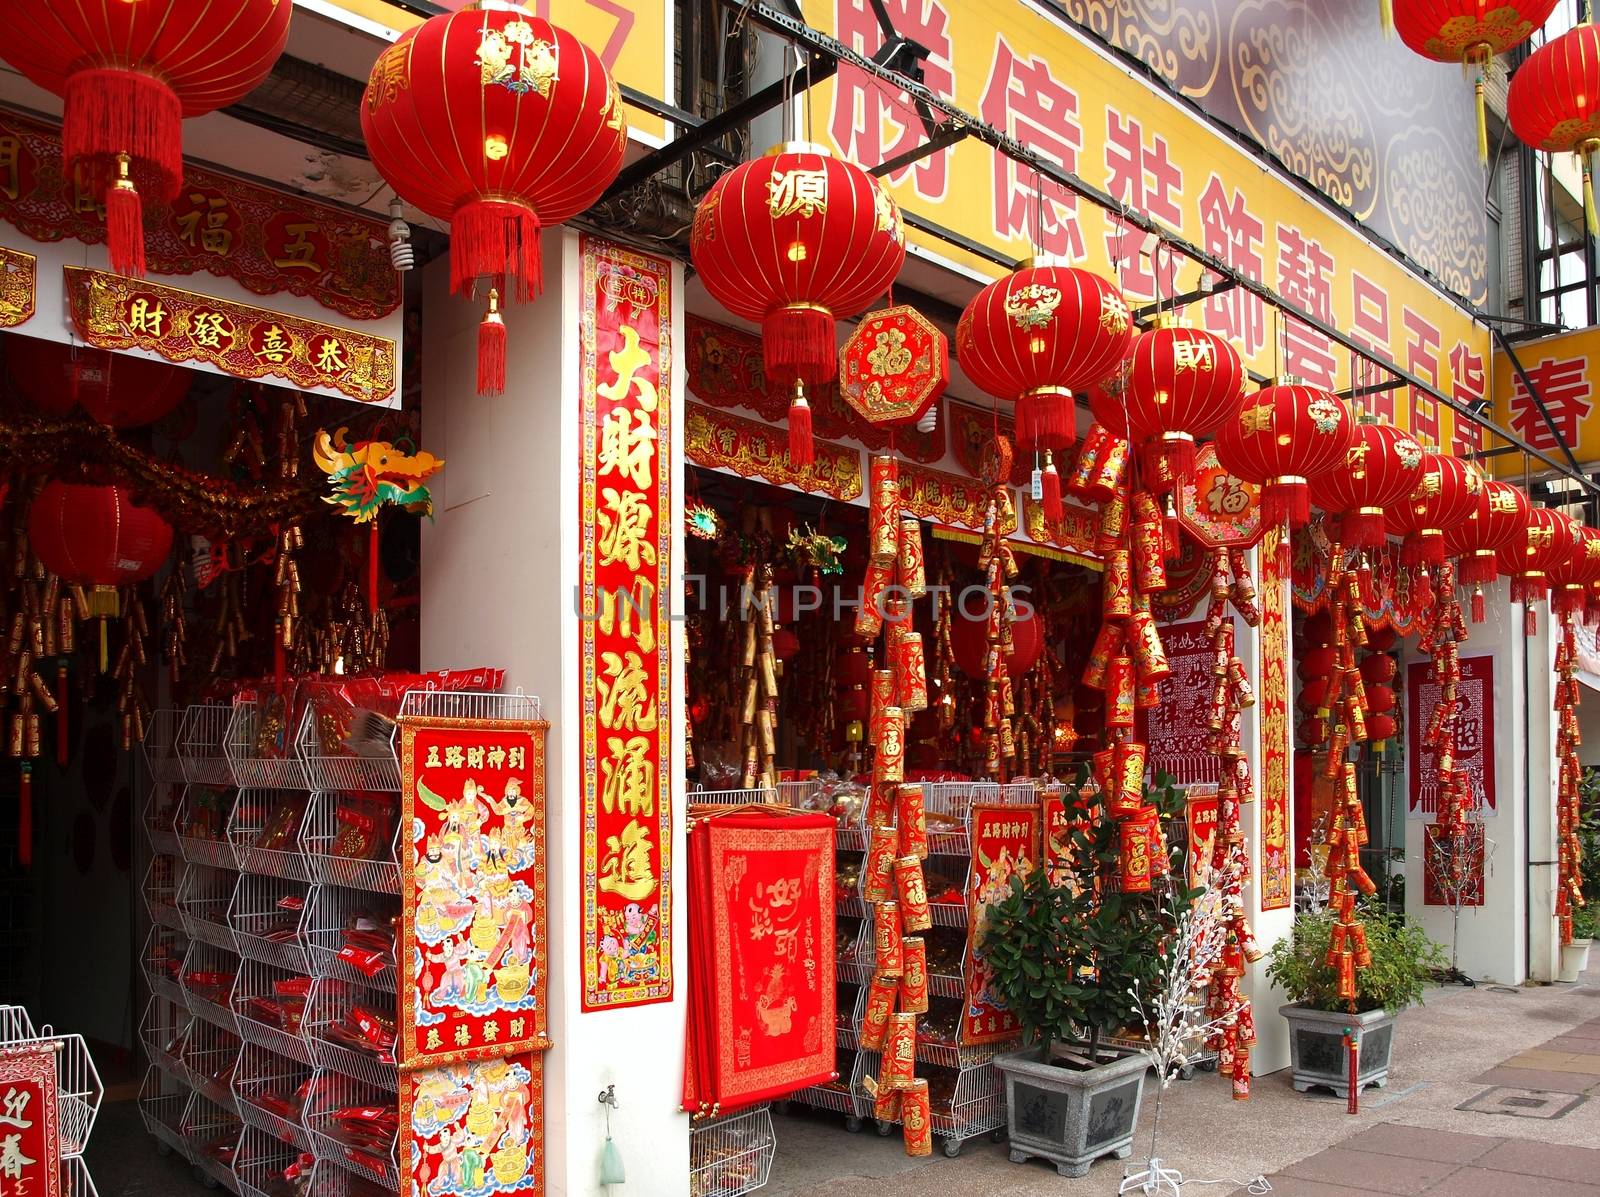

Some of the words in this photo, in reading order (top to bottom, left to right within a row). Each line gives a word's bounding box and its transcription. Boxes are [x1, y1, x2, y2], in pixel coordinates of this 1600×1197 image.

[768, 169, 828, 217] 源
[866, 327, 913, 377] 福
[1172, 339, 1214, 374] 財
[1510, 357, 1596, 452] 春
[1207, 475, 1249, 515] 福
[424, 745, 525, 770] 五路財神到
[906, 878, 927, 906] 福
